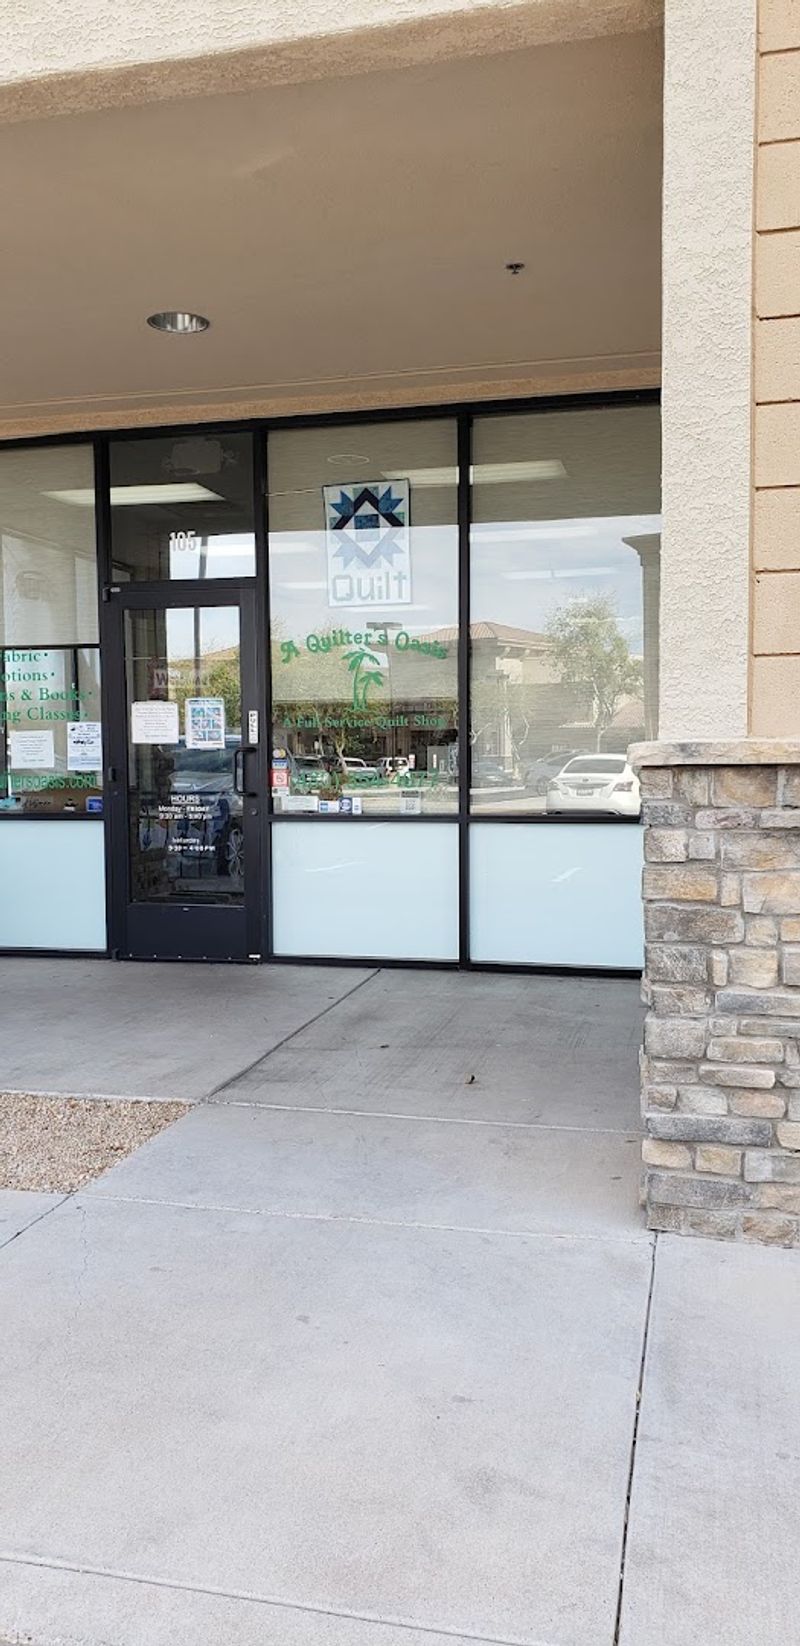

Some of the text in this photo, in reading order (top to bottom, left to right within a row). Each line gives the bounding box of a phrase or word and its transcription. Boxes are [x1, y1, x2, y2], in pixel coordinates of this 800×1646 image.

[169, 531, 197, 552] 105
[332, 571, 407, 601] Quilt
[280, 640, 300, 664] A
[395, 631, 448, 660] Oasis
[21, 688, 32, 701] &
[282, 714, 447, 730] A Full Service Quilt Shop
[170, 794, 201, 804] HOURS
[158, 805, 182, 814] Monday
